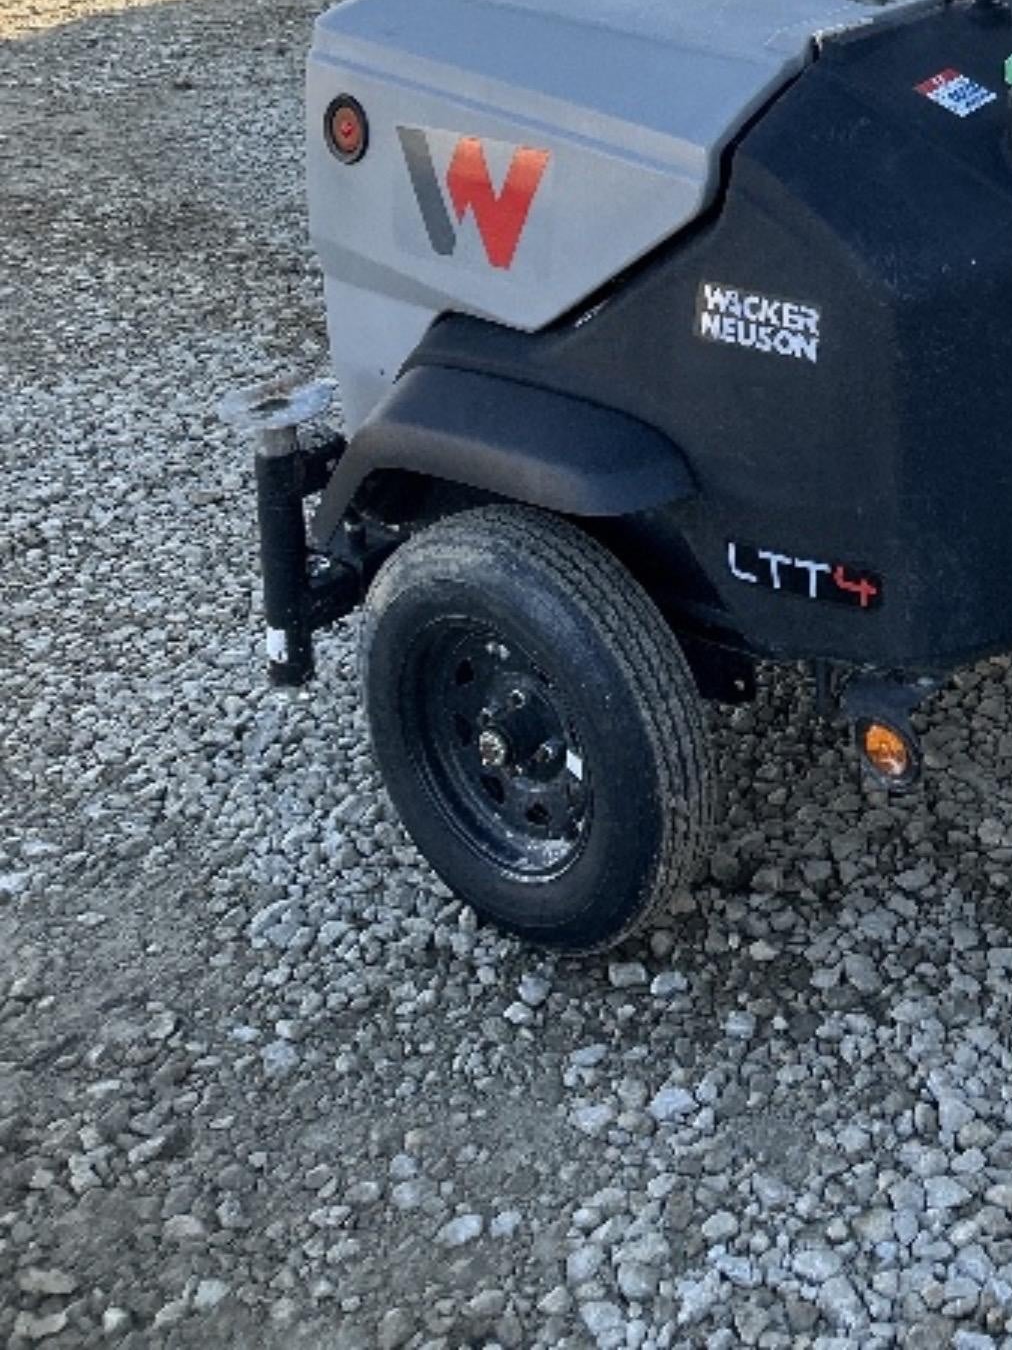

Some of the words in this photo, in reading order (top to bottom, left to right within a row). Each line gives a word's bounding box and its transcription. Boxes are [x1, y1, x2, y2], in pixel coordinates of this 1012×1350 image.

[701, 310, 819, 363] NEUSON
[703, 283, 819, 337] WACKER
[727, 542, 878, 607] LTT4
